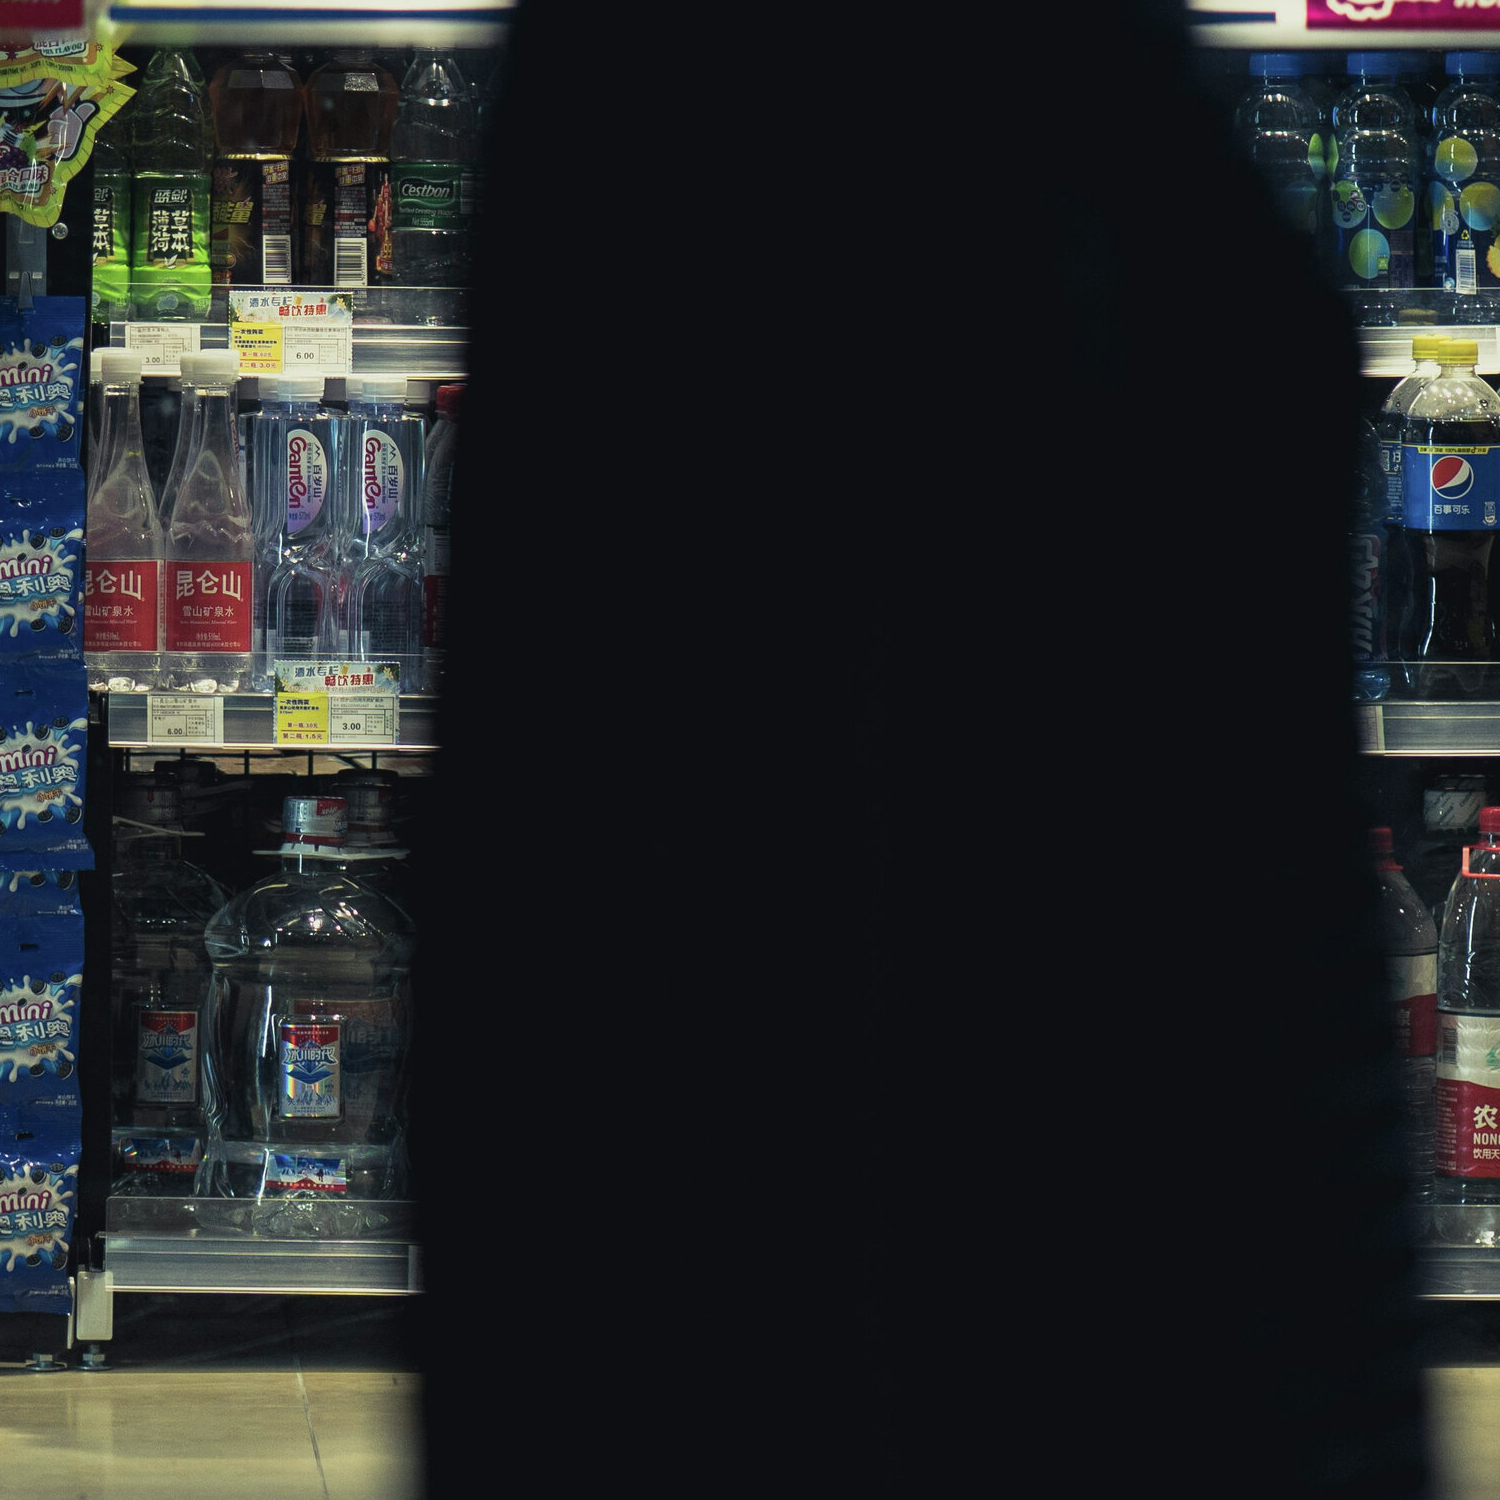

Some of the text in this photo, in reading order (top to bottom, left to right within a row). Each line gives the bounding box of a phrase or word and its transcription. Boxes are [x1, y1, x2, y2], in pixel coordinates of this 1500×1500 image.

[154, 189, 188, 203] 蓝剑
[152, 210, 190, 252] 草本 薄荷
[249, 296, 293, 308] 酒水专栏
[279, 304, 327, 317] 畅饮特惠
[296, 352, 315, 360] 6.00
[313, 464, 323, 498] 百岁山
[388, 465, 398, 499] 百岁山
[1433, 504, 1470, 514] 百事可乐
[176, 569, 242, 601] 昆仑山
[183, 605, 234, 617] 雪山矿泉水
[295, 665, 339, 677] 酒水专栏
[325, 674, 374, 686] 畅饮特惠
[282, 1048, 338, 1065] 冰川时代
